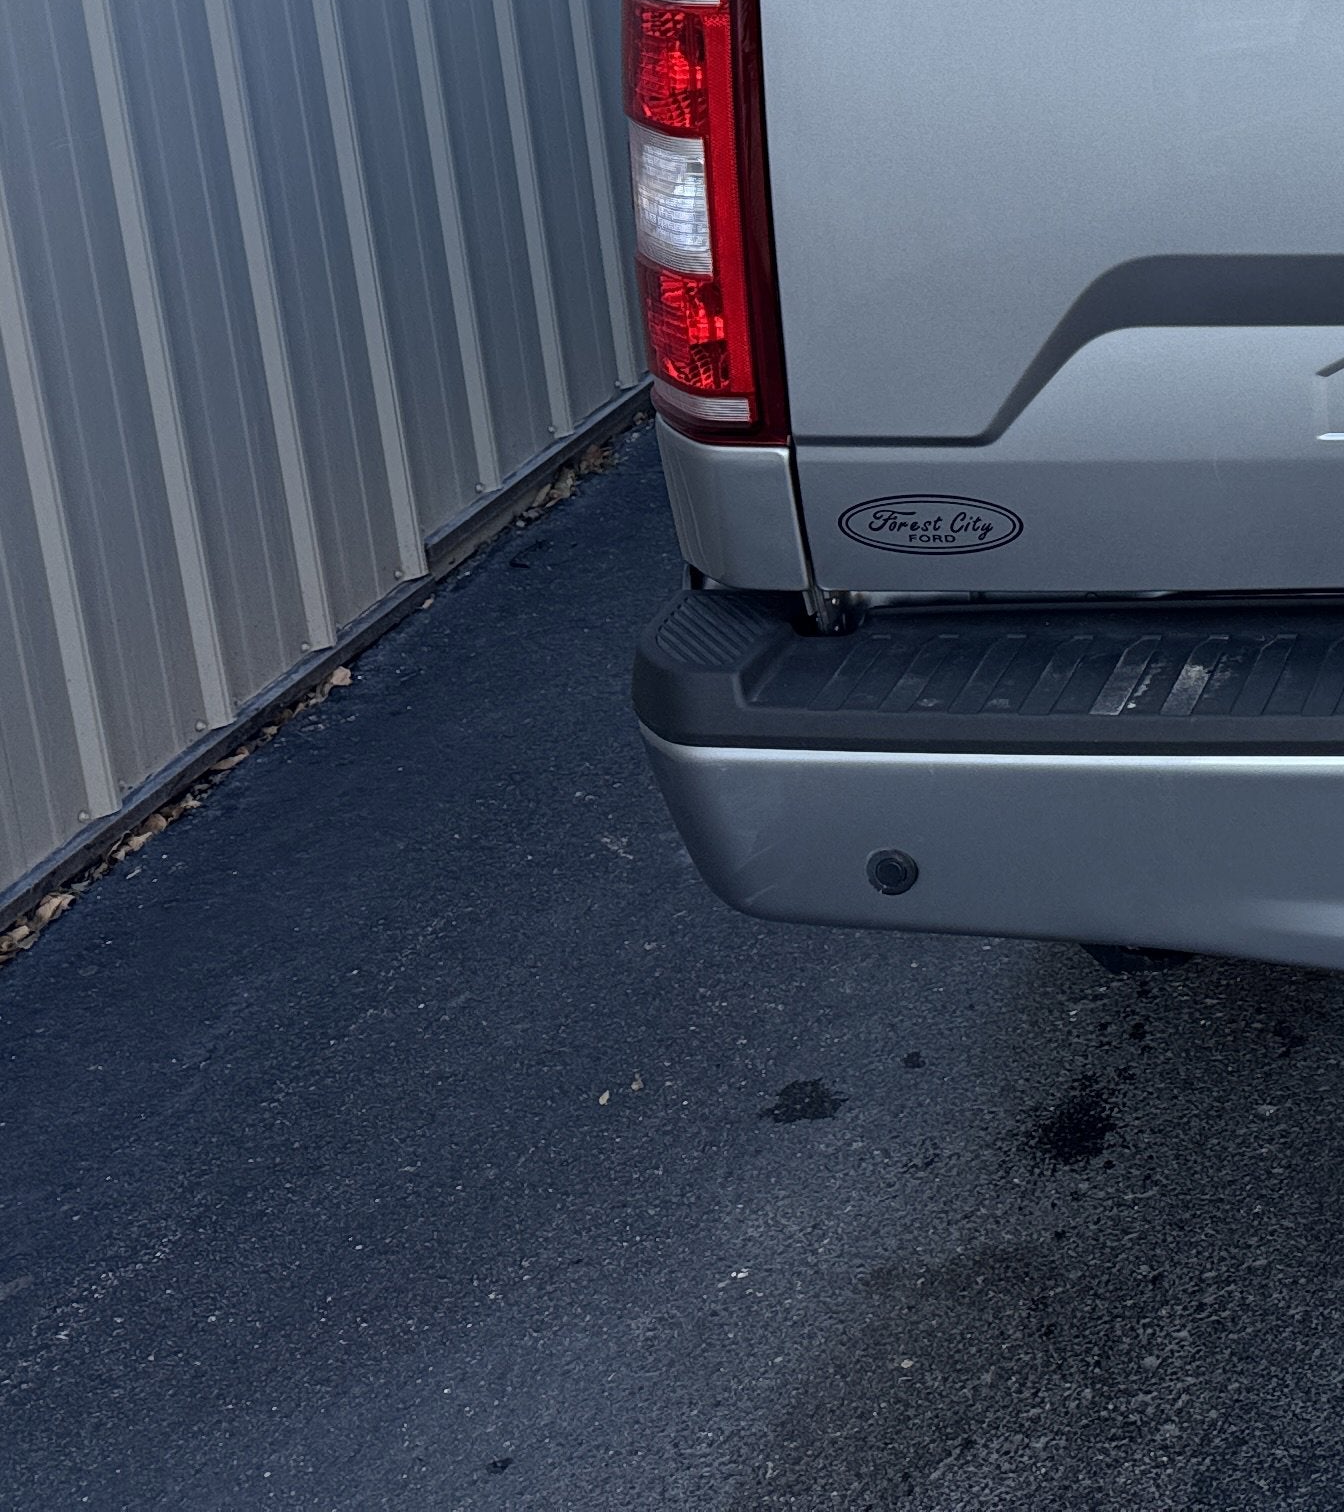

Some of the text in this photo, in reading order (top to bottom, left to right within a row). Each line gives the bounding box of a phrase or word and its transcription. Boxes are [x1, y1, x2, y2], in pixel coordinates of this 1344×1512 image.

[868, 509, 994, 541] Forest City
[908, 534, 957, 543] FORD
